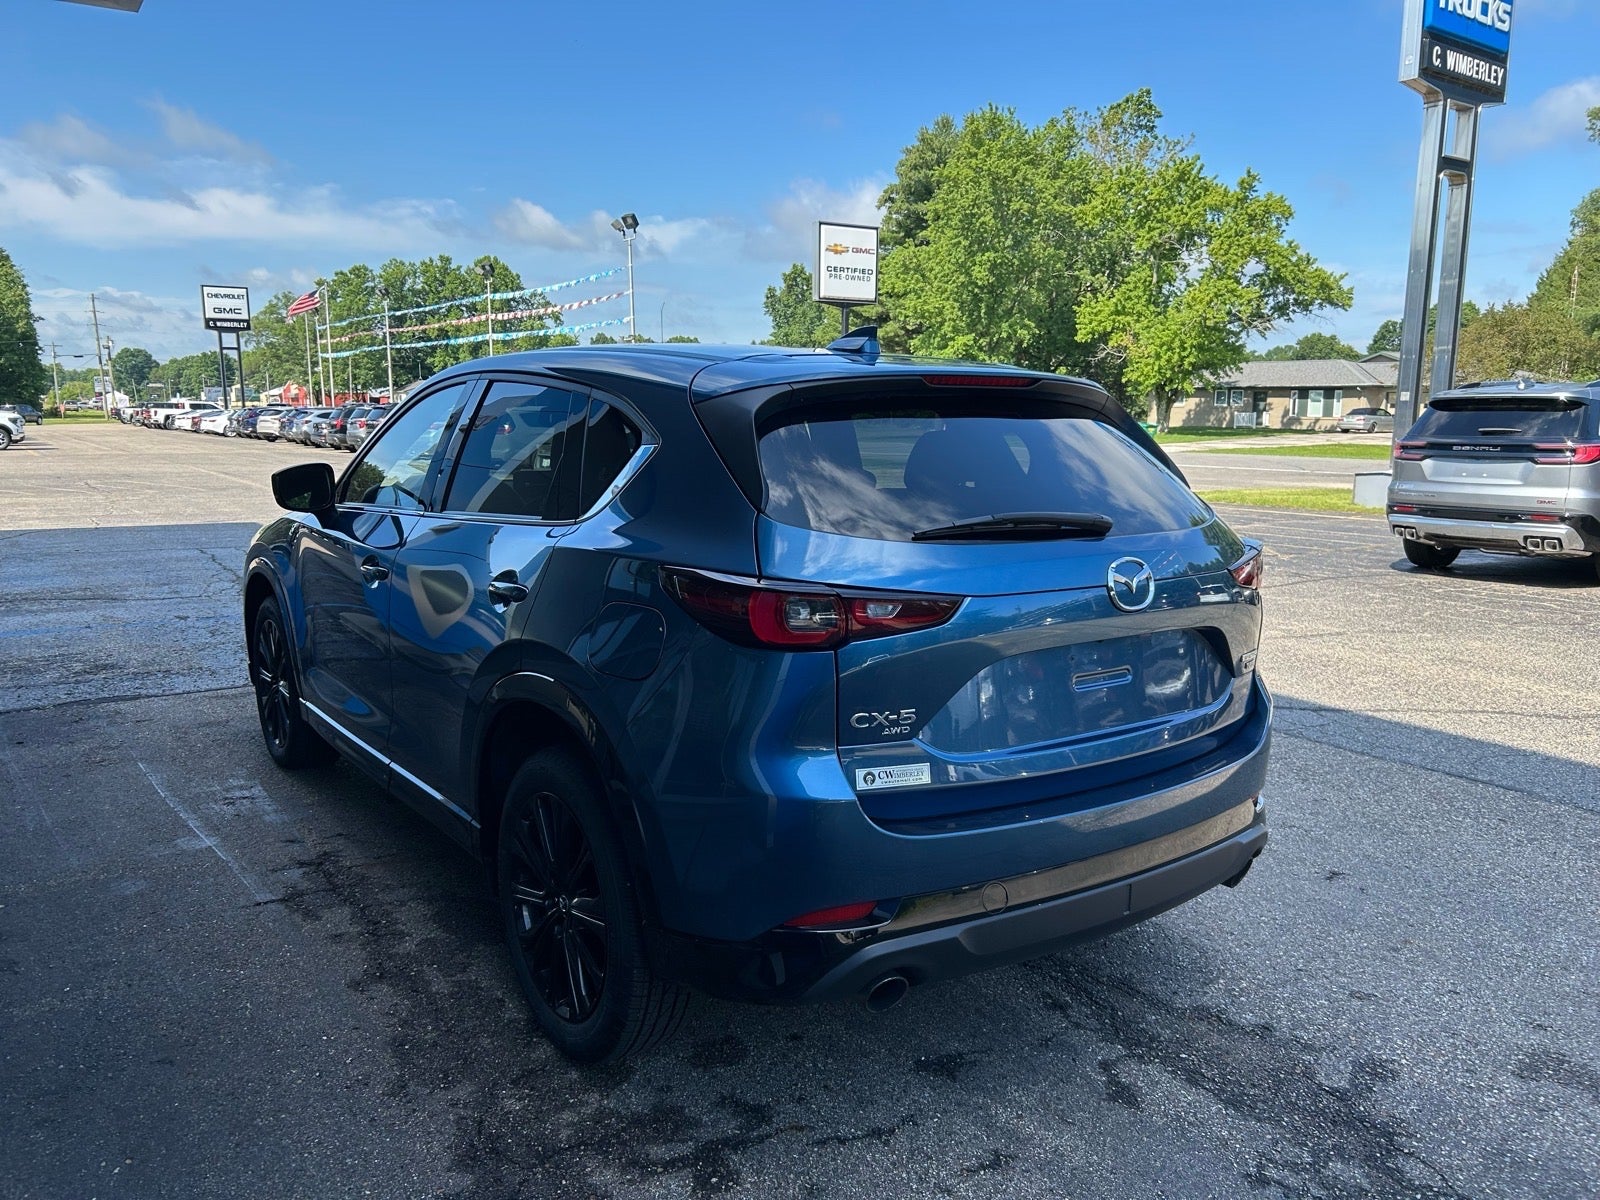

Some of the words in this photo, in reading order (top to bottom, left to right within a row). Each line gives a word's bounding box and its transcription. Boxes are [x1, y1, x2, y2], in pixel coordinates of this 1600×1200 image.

[1438, 0, 1511, 32] UCKS
[1432, 45, 1442, 68] C.
[1446, 49, 1505, 86] WIMBERLEY
[851, 247, 876, 255] GMC
[826, 265, 874, 275] CERTIFIED
[828, 273, 871, 282] PRE-OWNED
[206, 292, 245, 300] CHEVROLET
[212, 307, 243, 315] GMC
[849, 708, 917, 729] CX-5
[881, 725, 911, 735] AWD
